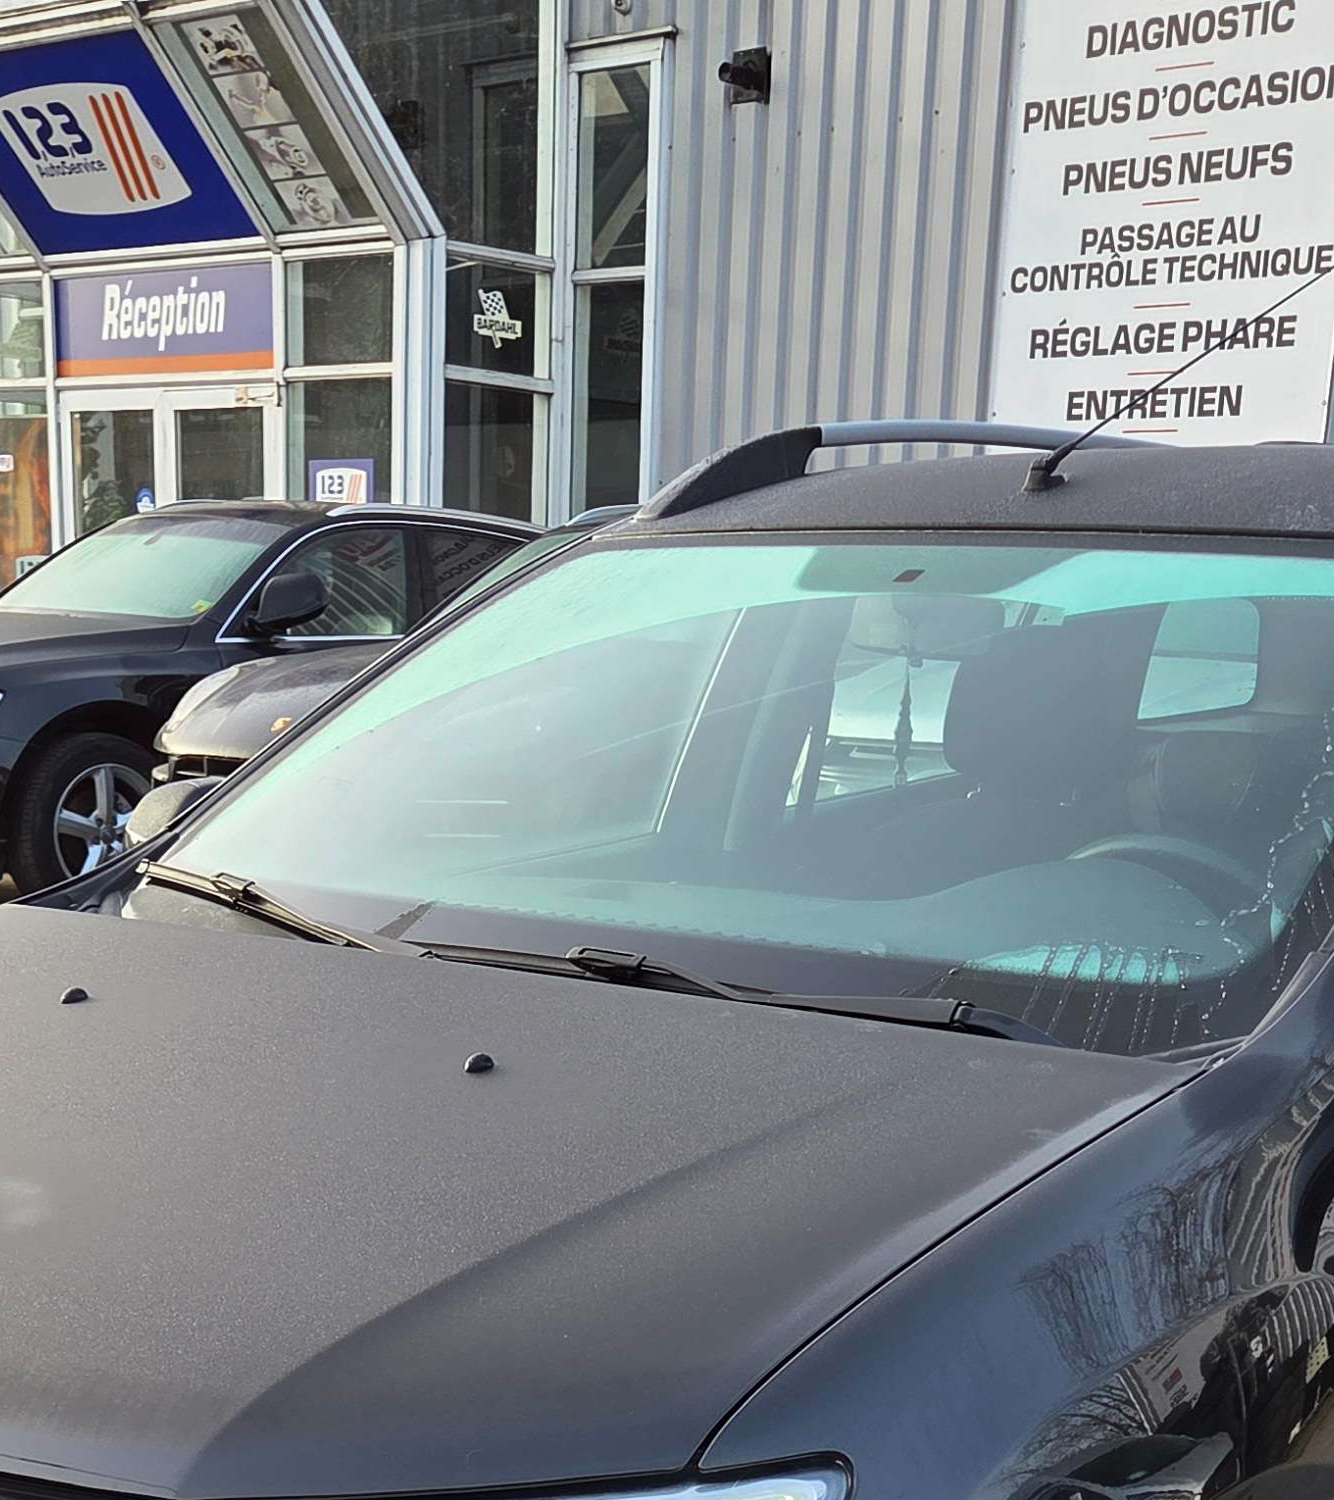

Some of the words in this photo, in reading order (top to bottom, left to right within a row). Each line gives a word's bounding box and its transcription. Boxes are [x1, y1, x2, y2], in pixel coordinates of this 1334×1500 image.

[1085, 0, 1296, 59] DIAGNOSTIC
[1022, 90, 1131, 134] PNEUS
[1062, 154, 1172, 196] PNEUS
[1178, 142, 1295, 185] NEUFS
[1080, 217, 1215, 256] PASSAGE
[1218, 214, 1262, 245] AU
[1010, 252, 1157, 294] CONTRÔLE
[1163, 244, 1334, 284] TECHNIQUE
[102, 276, 226, 351] Réception
[476, 317, 519, 334] BARDAHL
[1028, 318, 1175, 361] RÉGLAGE
[1181, 315, 1298, 352] PHARE
[1066, 384, 1244, 422] ENTRETIEN
